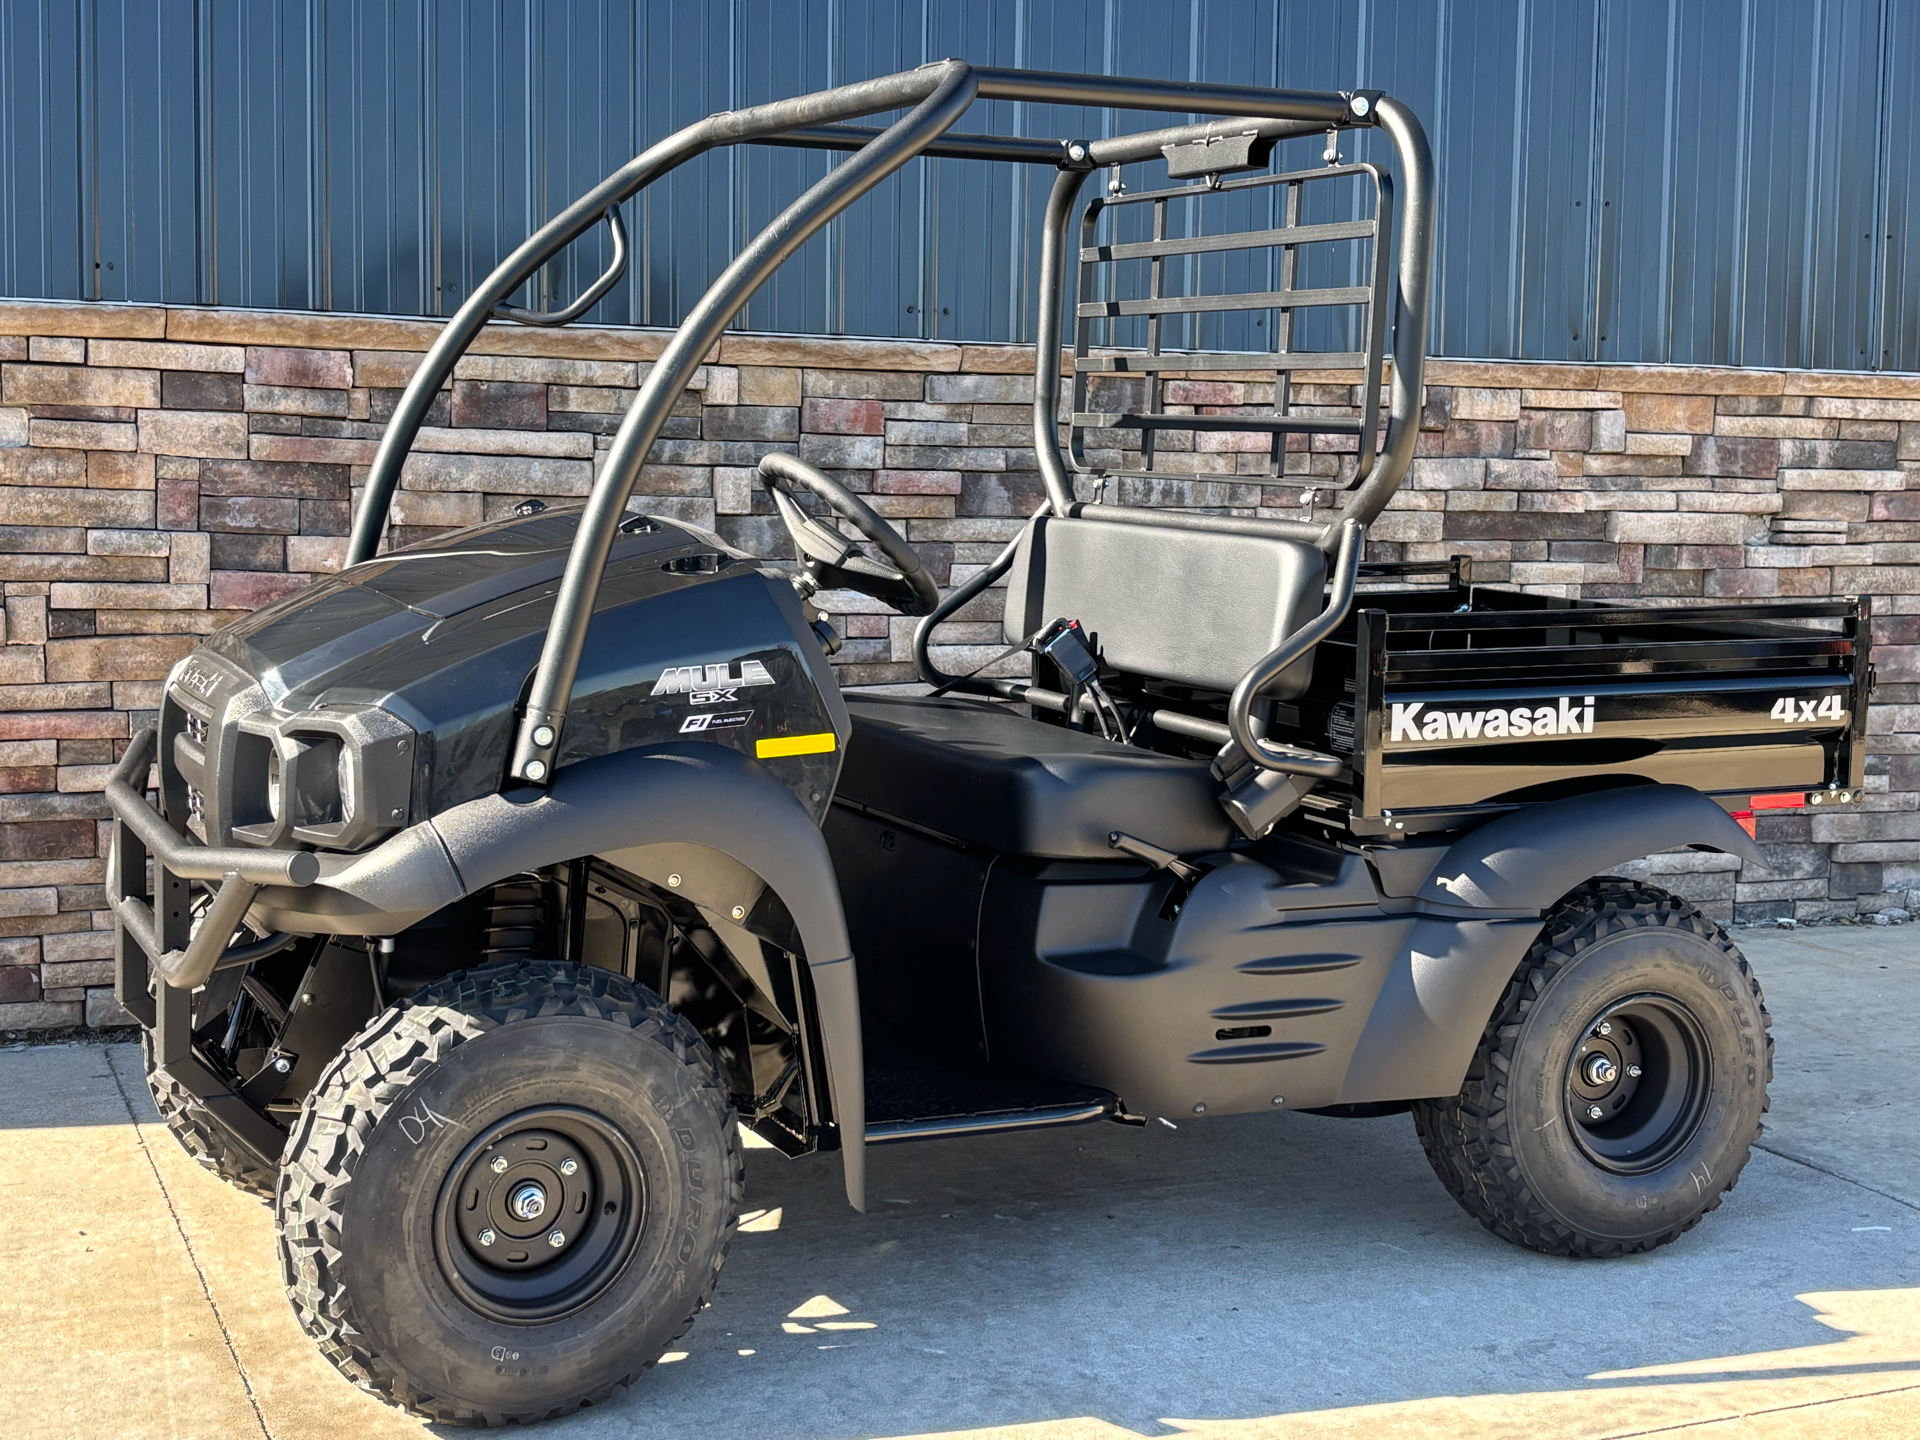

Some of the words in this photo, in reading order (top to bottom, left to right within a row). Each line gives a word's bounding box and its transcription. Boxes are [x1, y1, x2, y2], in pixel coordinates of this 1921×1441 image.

[650, 660, 776, 696] MULE
[689, 688, 739, 706] SX
[1390, 696, 1595, 742] Kawasaki
[1770, 694, 1846, 724] 4x4
[1720, 983, 1757, 1089] DURO
[673, 1127, 706, 1264] DURO
